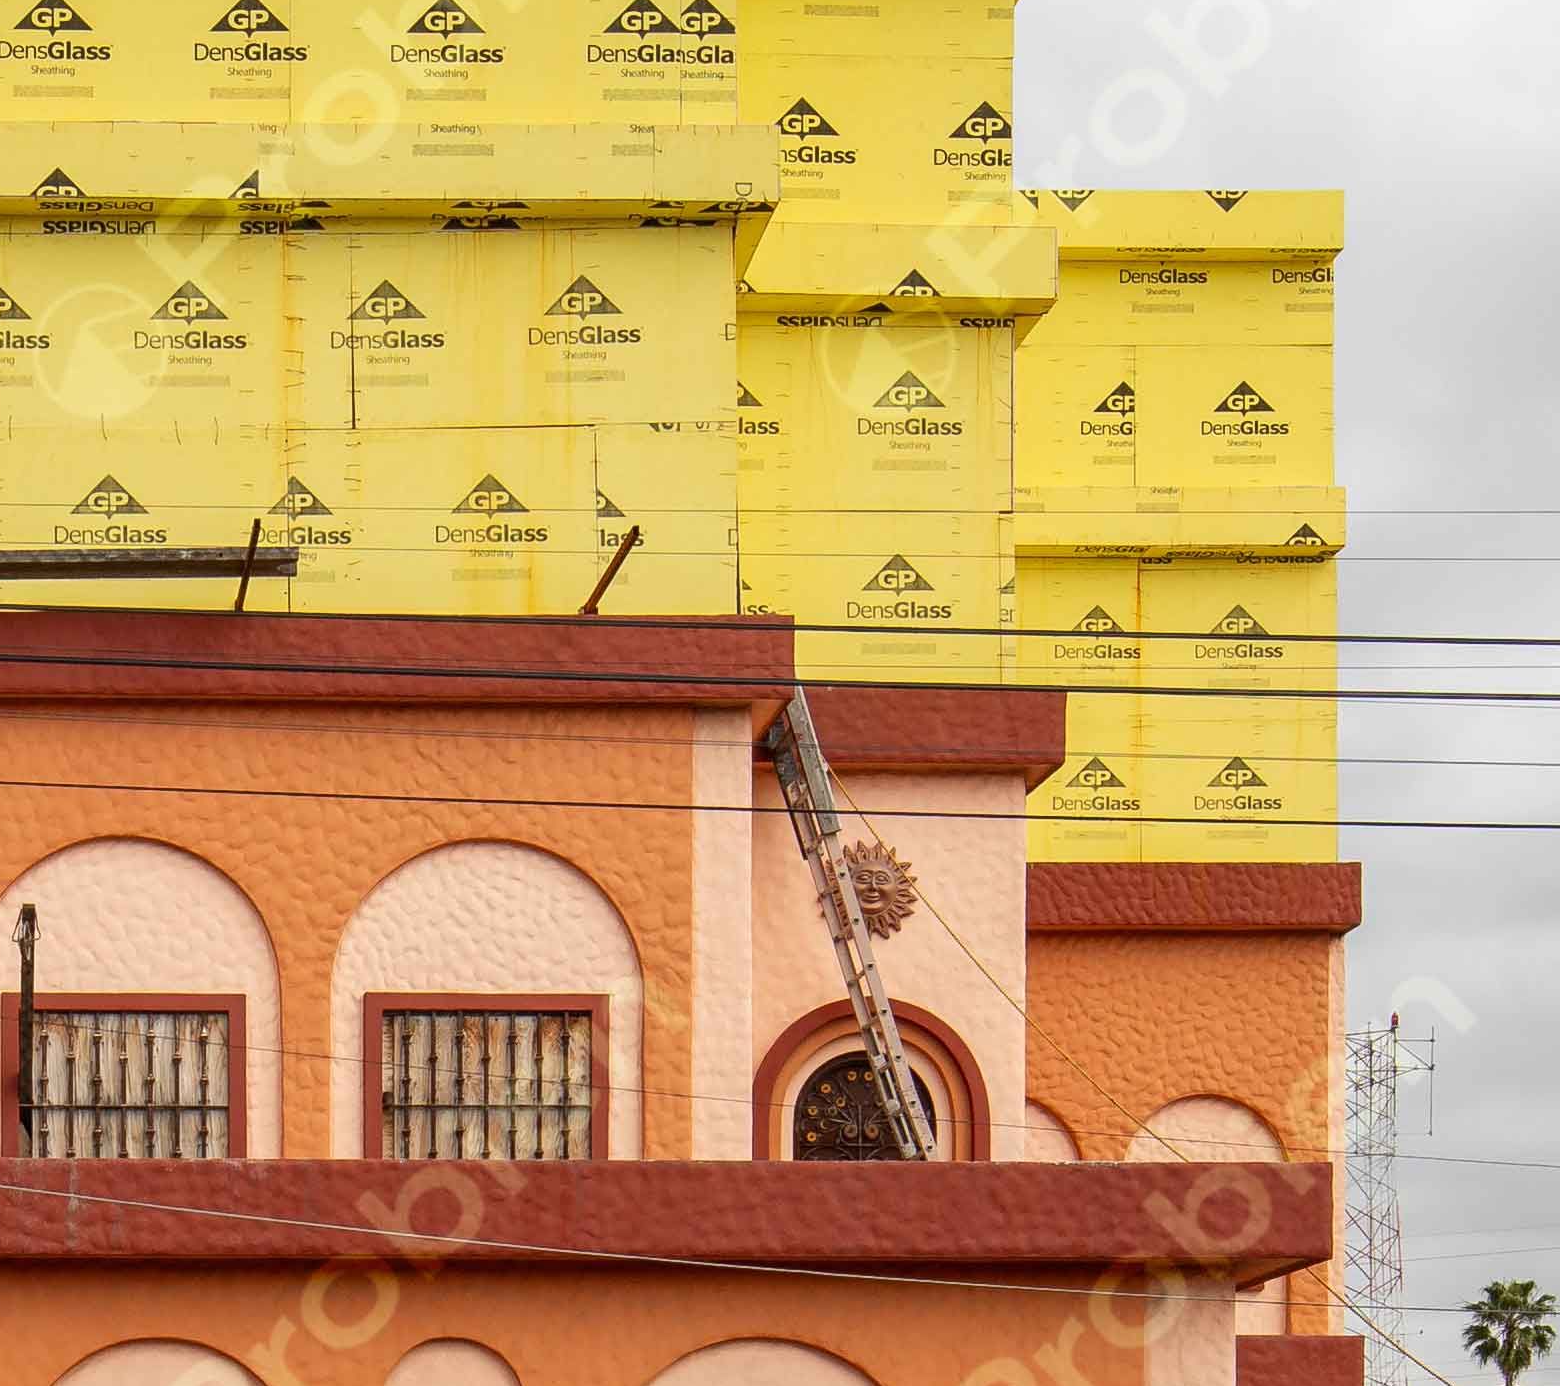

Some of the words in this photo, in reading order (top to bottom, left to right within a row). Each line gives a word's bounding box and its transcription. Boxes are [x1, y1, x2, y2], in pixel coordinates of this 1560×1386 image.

[32, 6, 73, 27] GP
[228, 8, 269, 30] GP
[424, 10, 464, 31] GP
[621, 10, 662, 31] GP
[682, 12, 721, 32] GP
[194, 42, 308, 63] DensGlass
[390, 43, 503, 65] DensGlass
[30, 64, 76, 78] Sheathing
[227, 66, 272, 79] Sheathing
[423, 67, 469, 80] Sheathing
[620, 67, 665, 80] Sheathing
[430, 123, 478, 135] Sheathing
[782, 114, 820, 133] GP
[965, 118, 1003, 136] GP
[933, 149, 1012, 167] DensGla
[781, 169, 823, 179] Sheathing
[964, 171, 1006, 182] Sheathing
[40, 200, 153, 213] DensGlass
[1119, 269, 1208, 284] DensGlass
[1272, 268, 1334, 283] DensGl
[1145, 288, 1180, 297] Sheathing
[167, 297, 209, 318] GP
[365, 297, 407, 318] GP
[560, 292, 602, 313] GP
[133, 329, 248, 351] DensGlass
[330, 330, 444, 350] DensGlass
[527, 325, 641, 346] DensGlass
[167, 354, 213, 366] Sheathing
[366, 354, 410, 366] Sheathing
[562, 349, 607, 361] Sheathing
[888, 386, 928, 405] GP
[1107, 395, 1135, 410] GP
[1226, 394, 1260, 410] GP
[857, 417, 962, 436] DensGlass
[1080, 421, 1136, 435] DensG
[1201, 420, 1289, 435] DensGlass
[888, 440, 931, 452] Sheathing
[1226, 440, 1262, 448] Sheathing
[89, 490, 128, 511] GP
[467, 490, 509, 511] GP
[53, 526, 167, 545] DensGlass
[434, 524, 548, 543] DensGlass
[469, 548, 514, 559] Sheathing
[878, 569, 917, 588] GP
[846, 601, 951, 619] DensGlass
[1081, 619, 1113, 632] GP
[1222, 619, 1254, 632] GP
[1054, 644, 1140, 659] DensGlass
[1195, 644, 1283, 658] DensGlass
[1079, 771, 1112, 785] GP
[1220, 770, 1253, 785] GP
[1052, 796, 1140, 811] DensGlass
[1194, 796, 1282, 810] DensGlass
